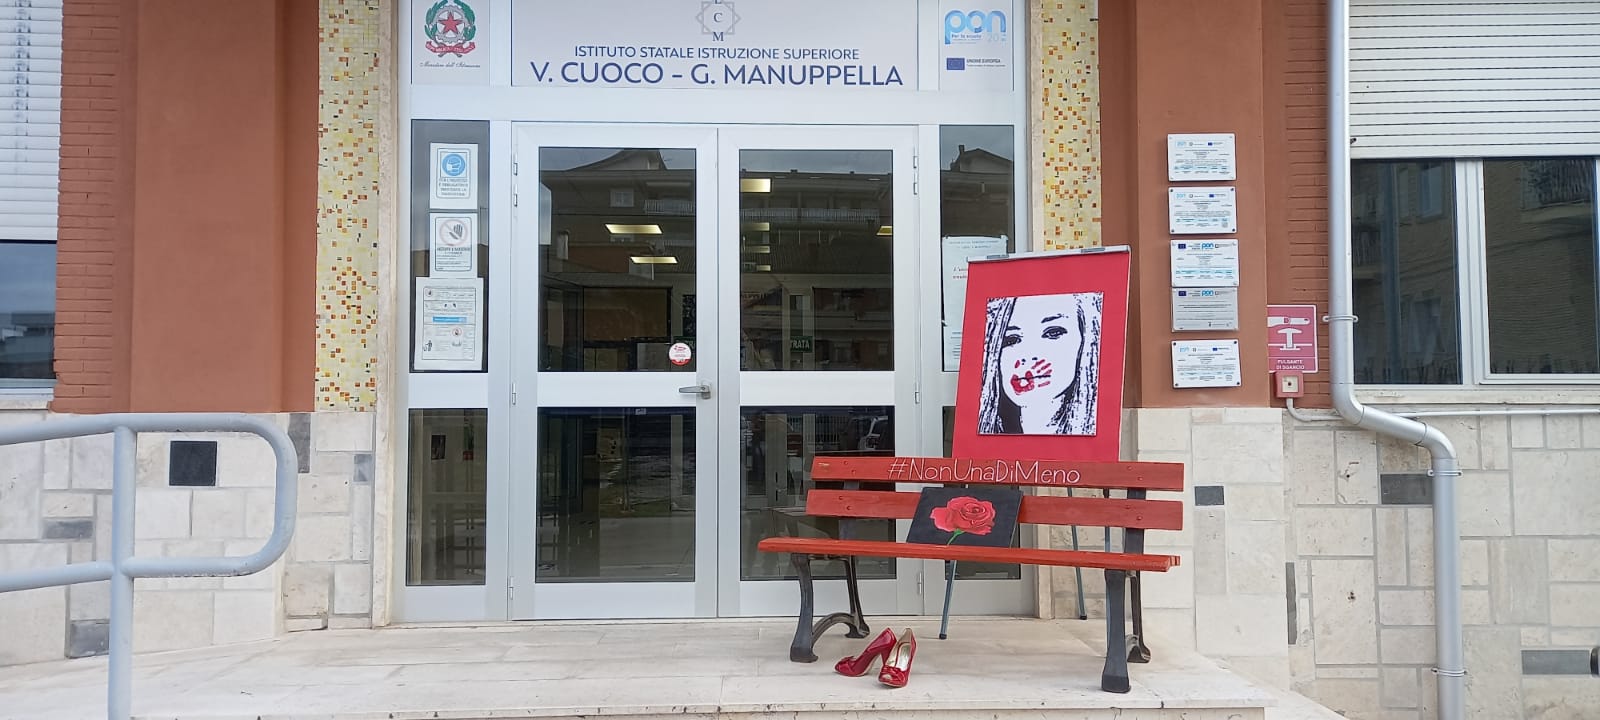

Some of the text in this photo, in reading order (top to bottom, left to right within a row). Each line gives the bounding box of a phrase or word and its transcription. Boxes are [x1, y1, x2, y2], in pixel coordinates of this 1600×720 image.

[713, 12, 723, 23] C
[712, 31, 724, 42] M
[575, 45, 860, 60] ISTITUTO STATALE ISTRUZIONE SUPERIORE
[530, 61, 553, 83] V.
[561, 61, 664, 84] CUOCO
[690, 63, 716, 85] G.
[724, 64, 904, 86] MANUPPELLA
[888, 458, 1080, 483] #NonUnaDiMeno
